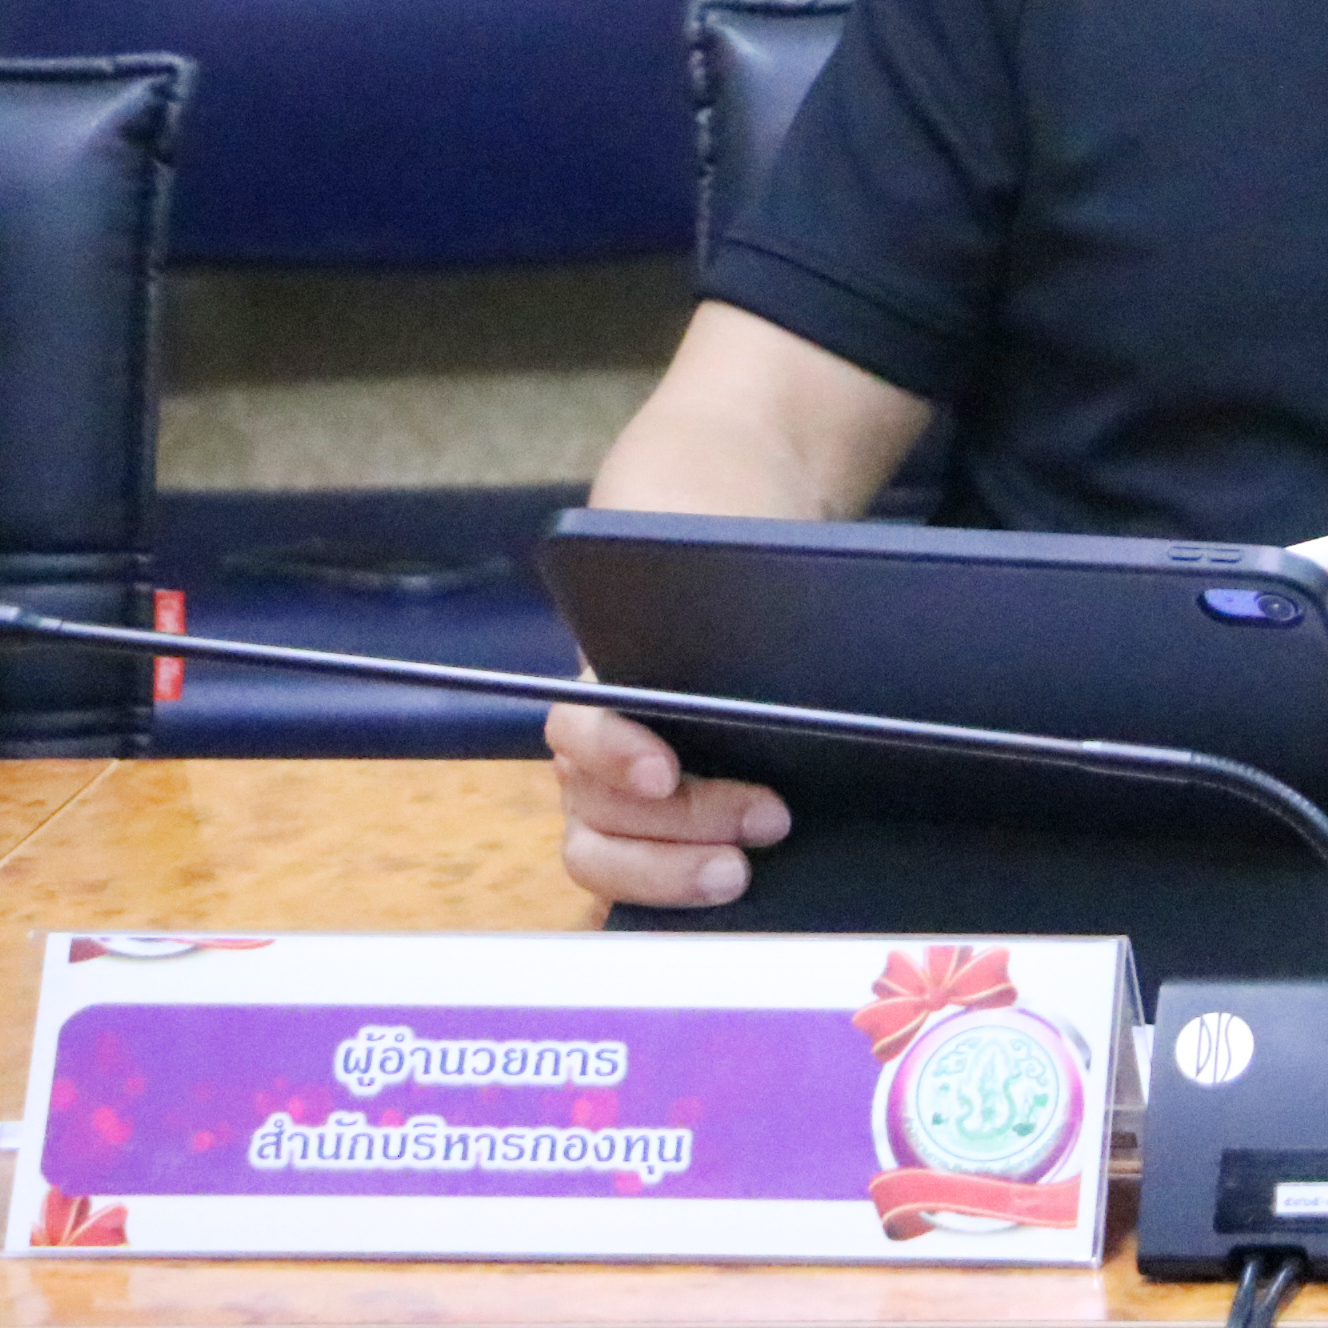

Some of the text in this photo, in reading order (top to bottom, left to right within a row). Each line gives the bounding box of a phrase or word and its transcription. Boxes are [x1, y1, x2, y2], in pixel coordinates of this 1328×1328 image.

[342, 1032, 620, 1087] ผู้อำนวยการ
[256, 1118, 686, 1175] สำนักบริหารกองทุน
